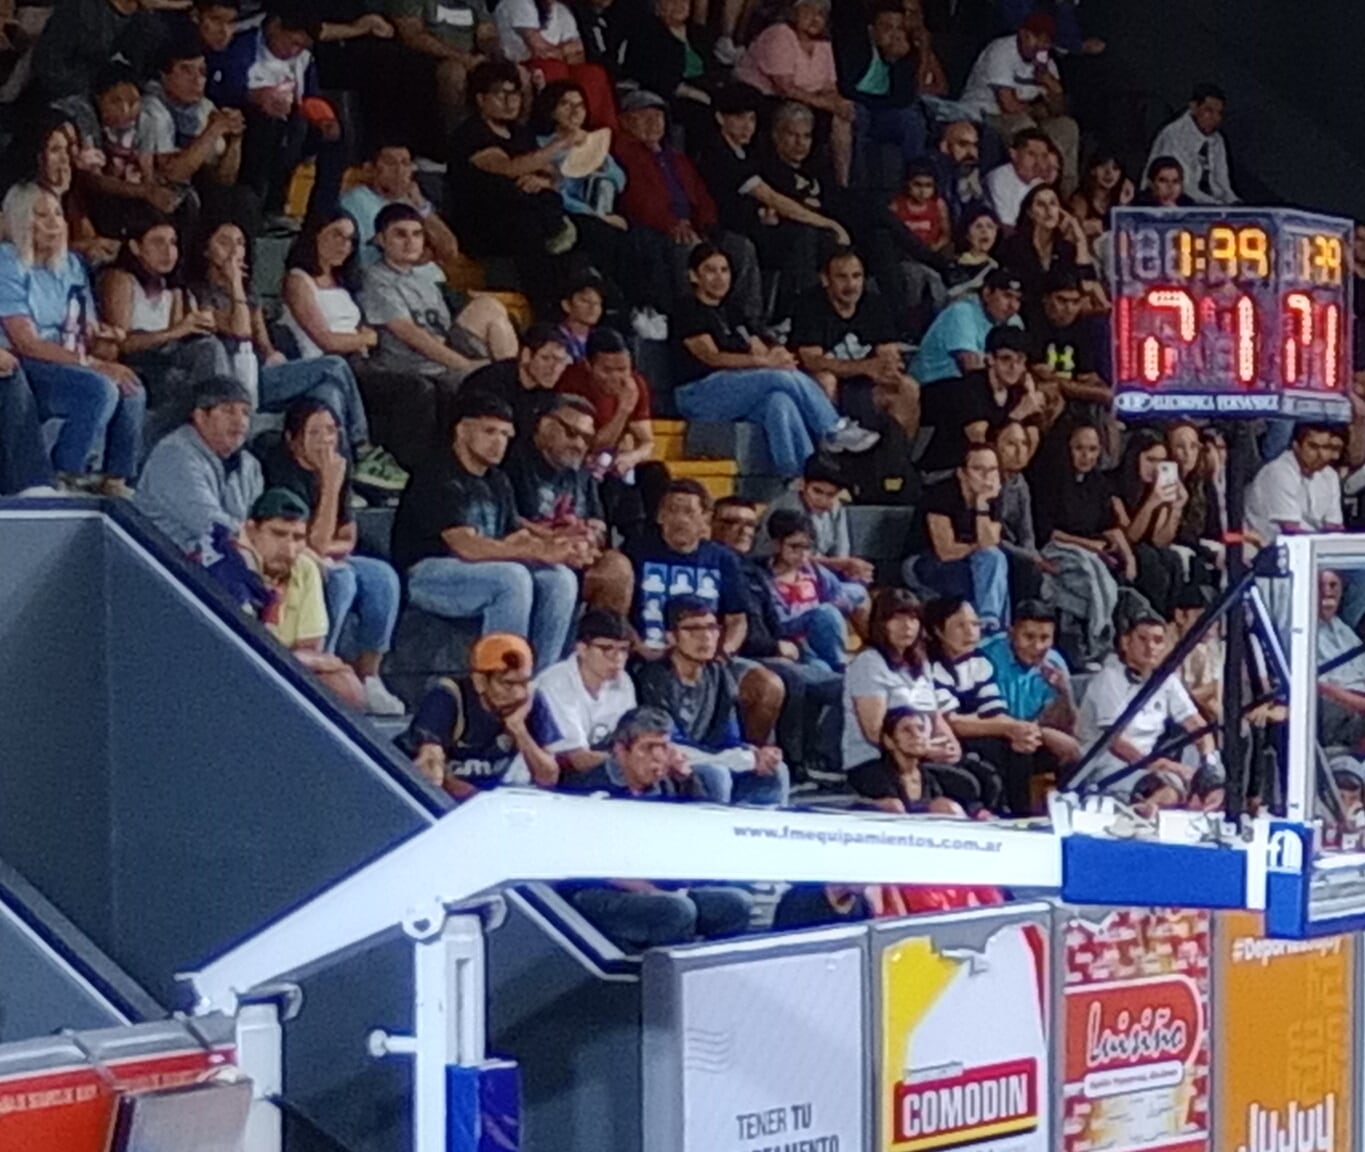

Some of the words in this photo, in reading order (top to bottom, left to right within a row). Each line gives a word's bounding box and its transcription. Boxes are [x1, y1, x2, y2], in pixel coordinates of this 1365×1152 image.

[733, 826, 1002, 852] www.fmequipamientos.com.ar
[736, 1107, 788, 1140] TENER
[791, 1102, 812, 1131] TU
[903, 1073, 1029, 1137] COMODIN
